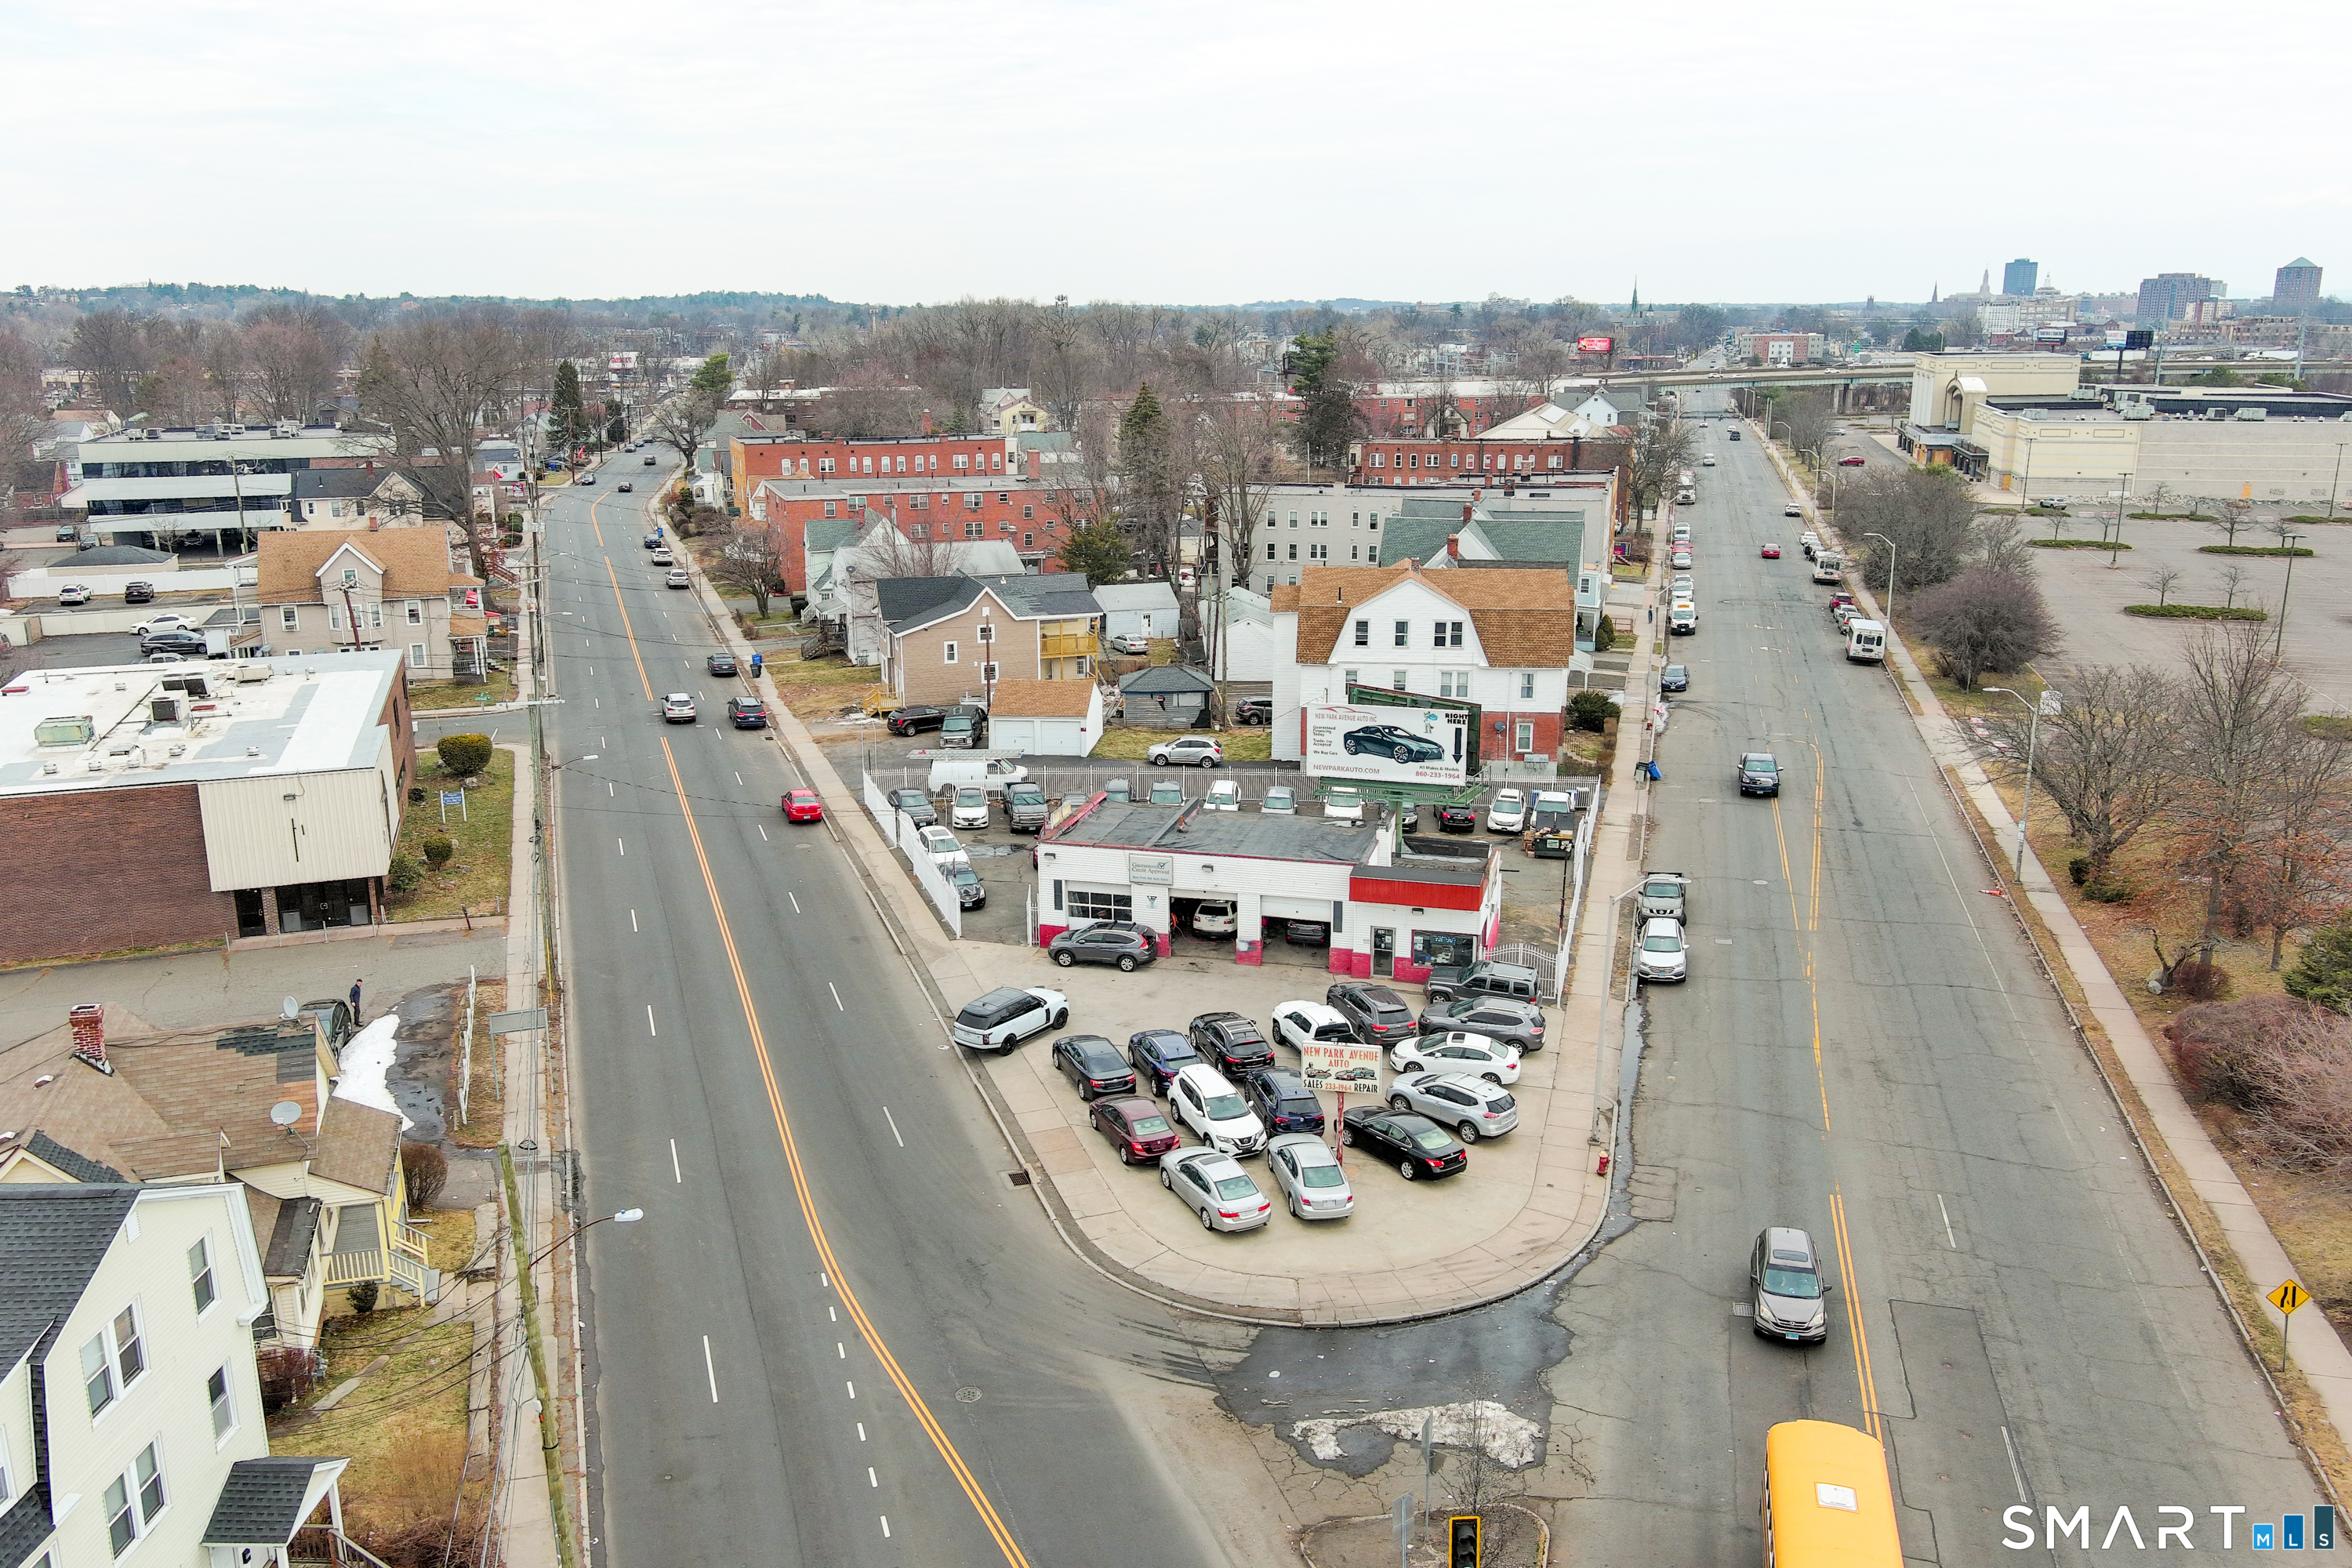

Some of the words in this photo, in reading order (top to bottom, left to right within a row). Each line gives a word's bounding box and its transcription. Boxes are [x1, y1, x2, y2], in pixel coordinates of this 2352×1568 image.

[1313, 764, 1380, 774] NEWPARKAUTO.COM
[1415, 771, 1460, 779] 860-233-1964
[1303, 1046, 1320, 1057] NEW
[1323, 1047, 1345, 1058] PARK
[1348, 1050, 1378, 1062] AVENUE
[1328, 1059, 1349, 1068] AUTO
[1303, 1080, 1323, 1088] SALES
[1325, 1083, 1352, 1091] 233-1964
[1354, 1083, 1377, 1093] REPAIR
